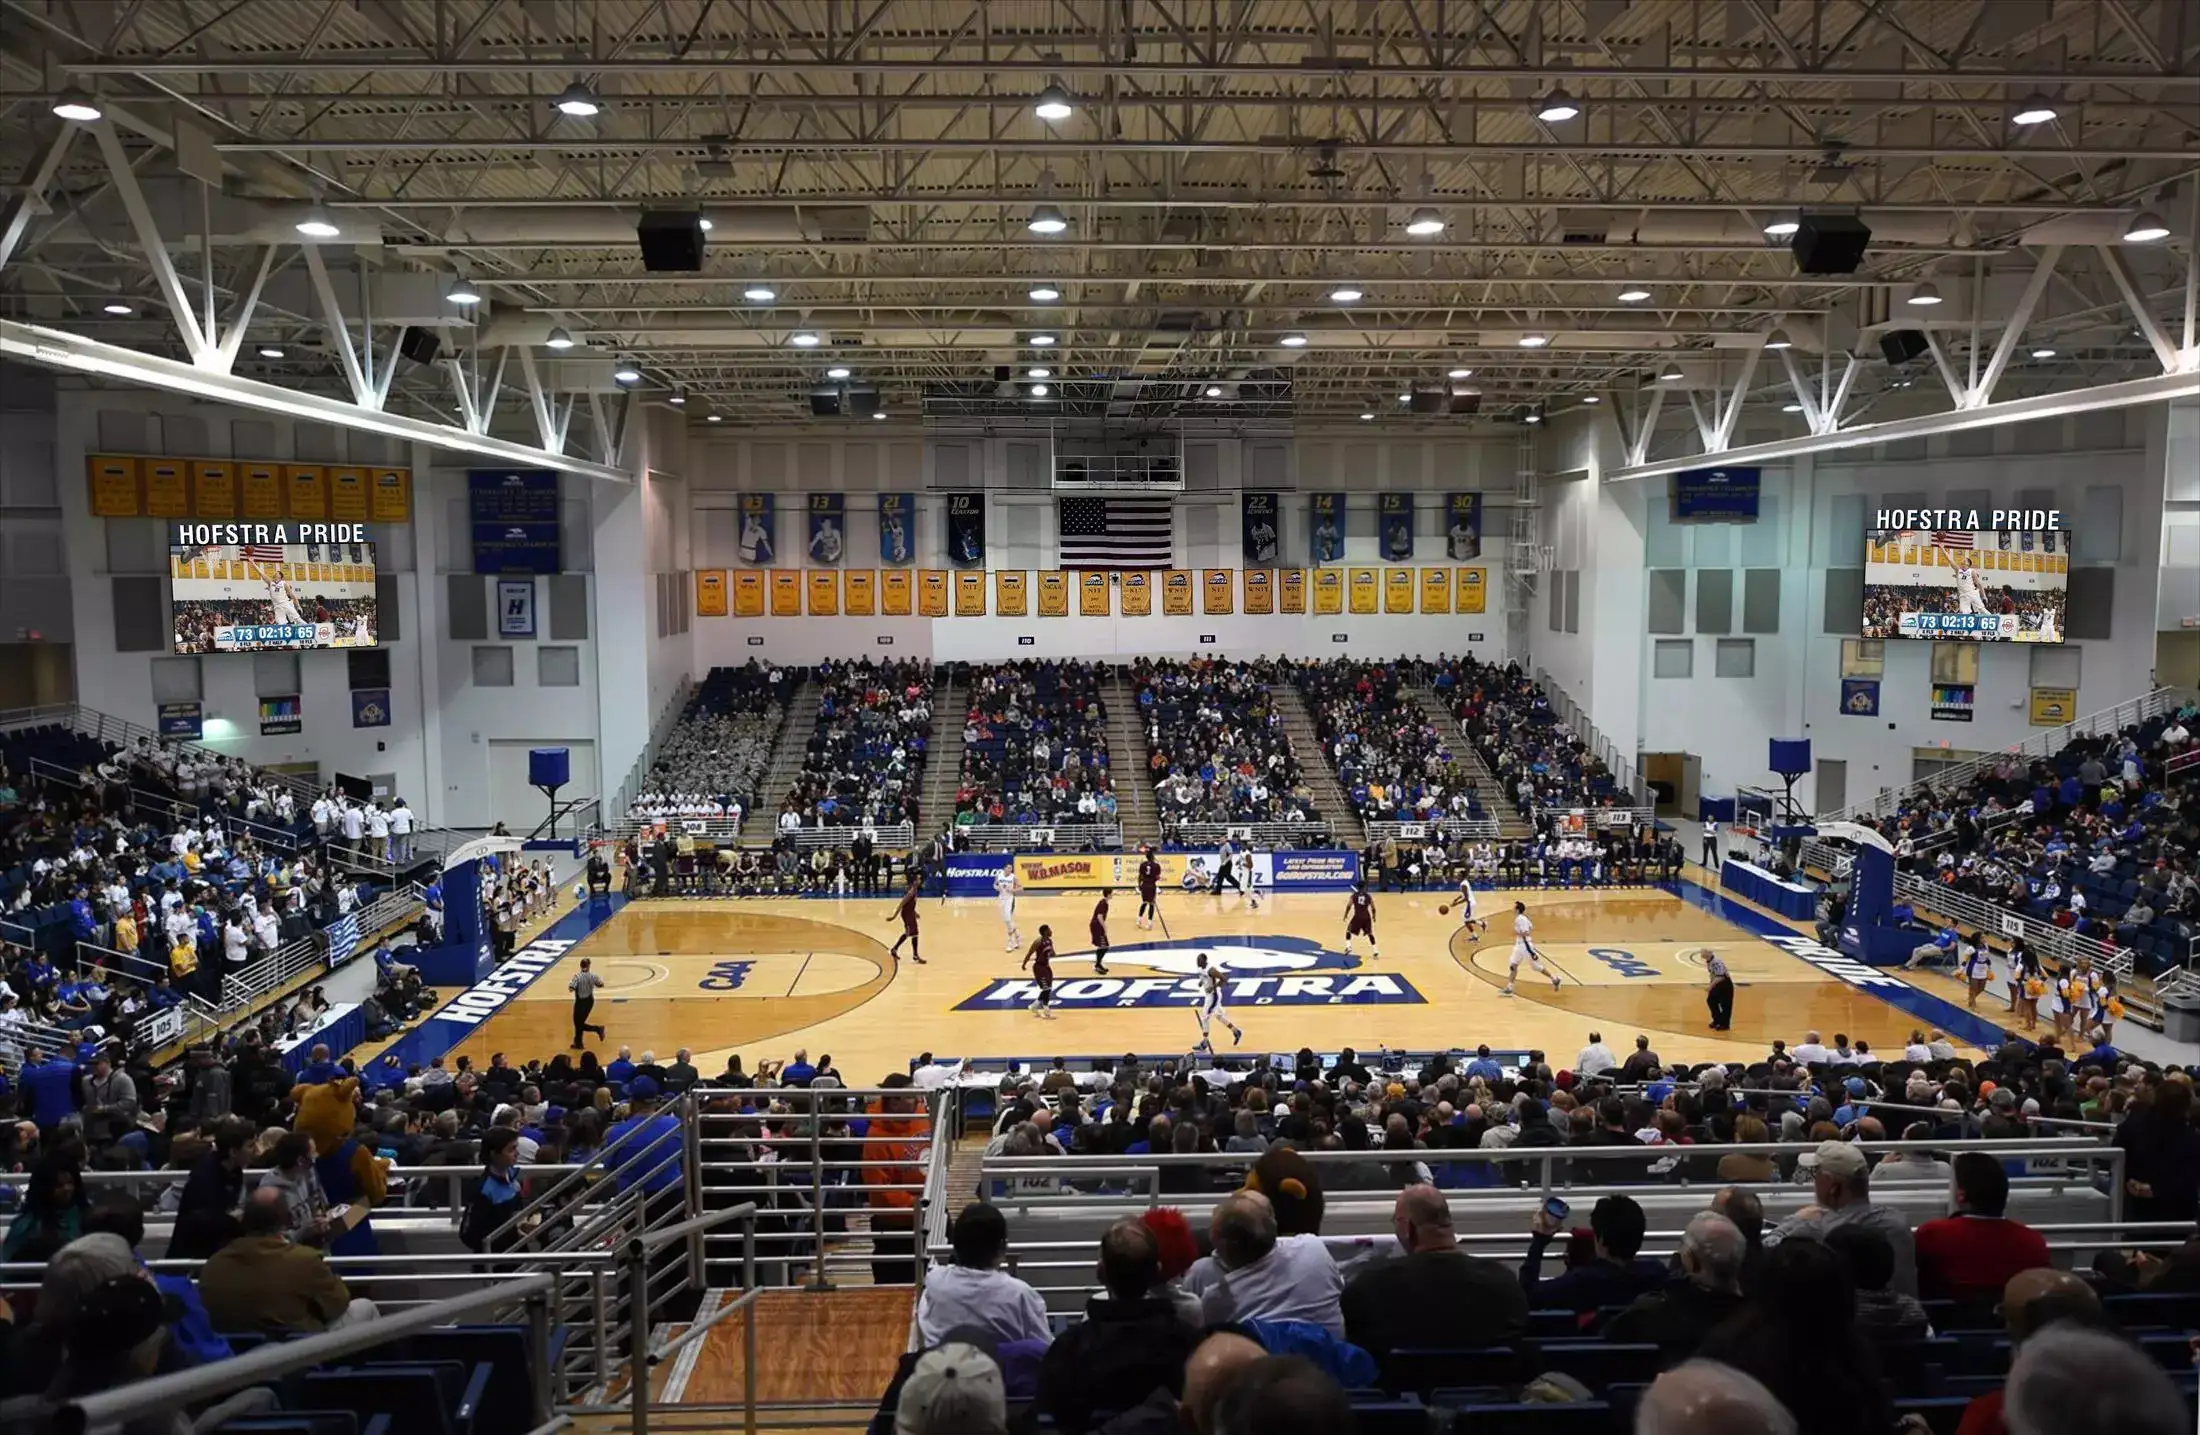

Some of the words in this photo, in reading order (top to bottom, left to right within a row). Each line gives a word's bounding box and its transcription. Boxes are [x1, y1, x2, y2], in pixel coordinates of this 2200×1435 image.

[811, 496, 830, 508] 13
[884, 496, 899, 508] 21
[953, 496, 970, 508] 10
[1249, 496, 1267, 507] 22
[1316, 495, 1332, 508] 14
[1384, 496, 1400, 508] 15
[1876, 509, 1980, 530] HOFSTRA
[1992, 510, 2060, 530] PRIDE
[179, 524, 288, 545] HOFSTRA
[300, 523, 364, 543] PRIDE
[1922, 616, 1937, 628] 73
[1942, 615, 1975, 628] 02:13
[1981, 617, 1996, 629] 65
[237, 628, 253, 640] 73
[258, 626, 292, 639] 02:13
[298, 626, 313, 638] 65
[1612, 813, 1627, 822] 113
[1404, 827, 1420, 836] 112
[2006, 919, 2019, 932] 115
[1587, 948, 1663, 978] CAA
[1760, 934, 1911, 988] PRIDE
[433, 939, 577, 1024] HOFSTRA
[698, 960, 758, 990] CAA
[984, 974, 1405, 1001] HOFSTRA
[156, 1018, 173, 1037] 105
[1022, 1177, 1051, 1188] 102
